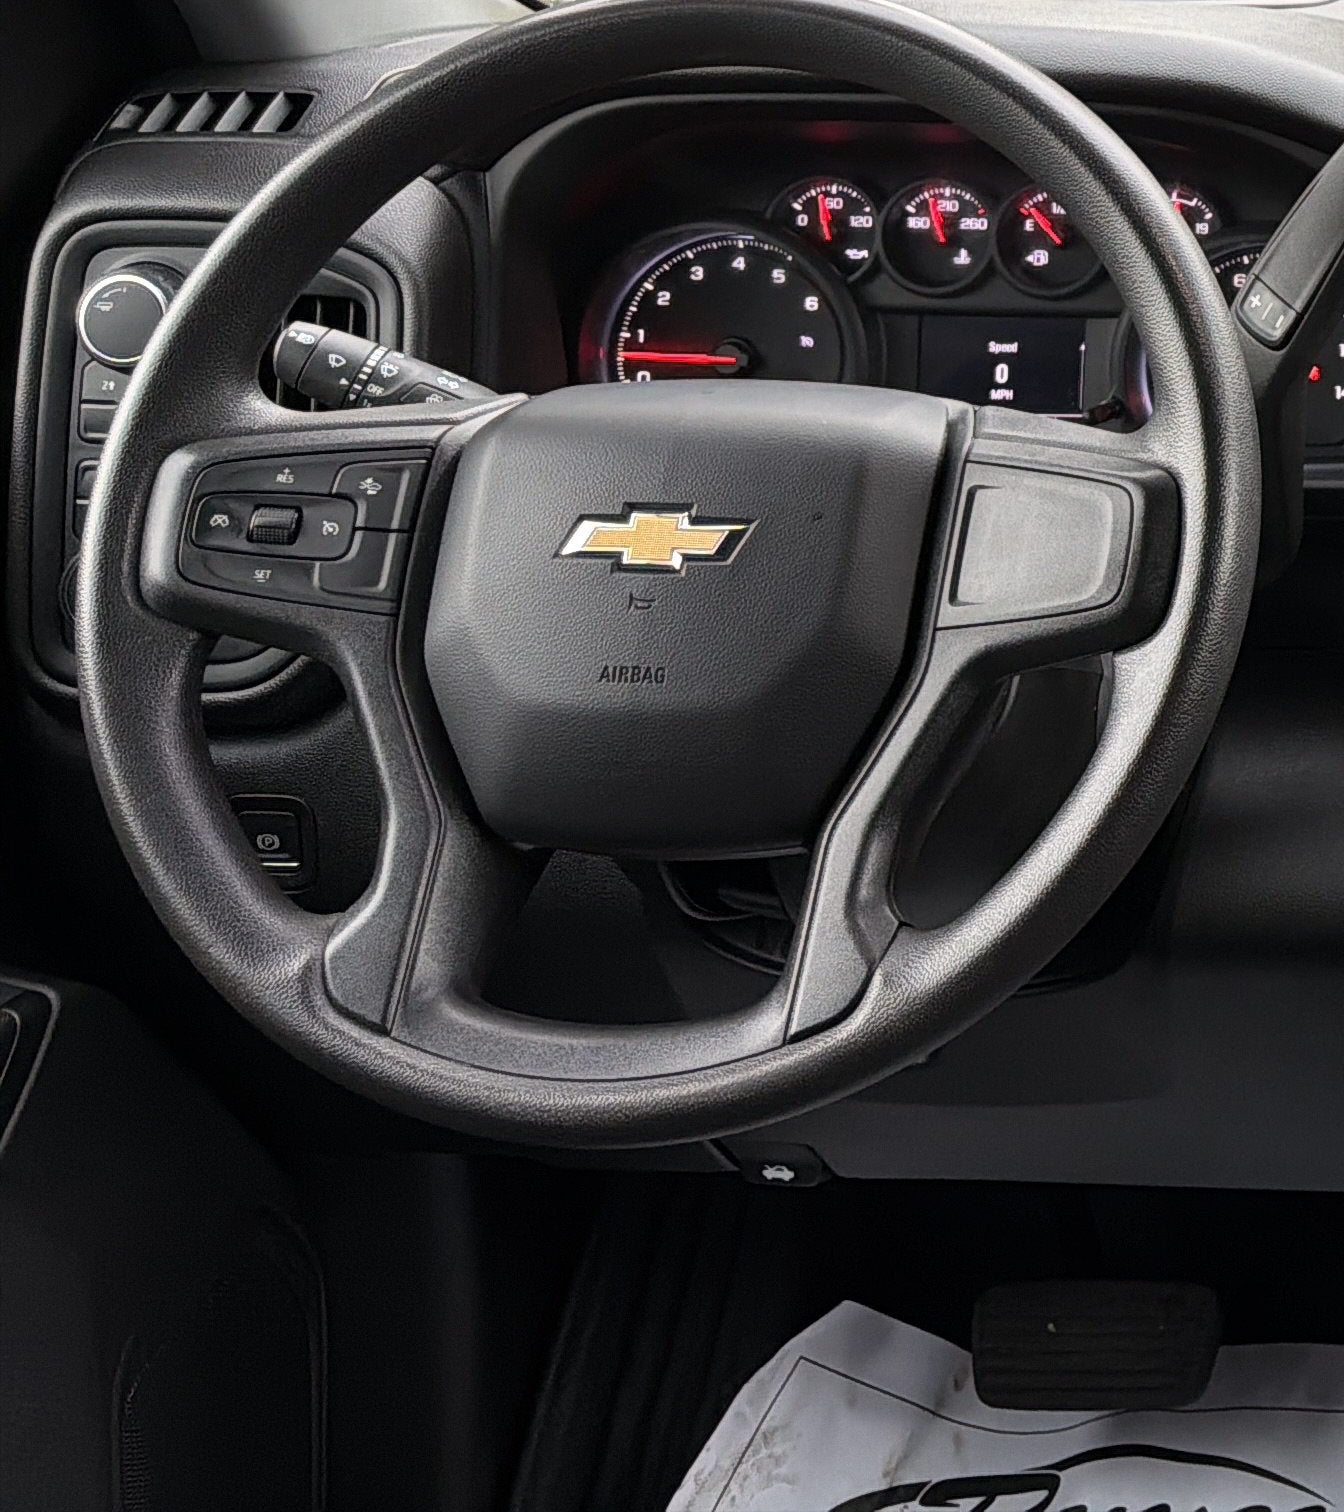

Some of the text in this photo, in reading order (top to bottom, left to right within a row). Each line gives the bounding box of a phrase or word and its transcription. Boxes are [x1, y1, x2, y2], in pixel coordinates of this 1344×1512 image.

[796, 216, 808, 227] 0
[850, 216, 873, 228] 120
[906, 216, 930, 229] 160
[959, 217, 988, 231] 260
[1024, 219, 1035, 231] E
[1195, 222, 1209, 234] 19
[731, 256, 746, 271] 4
[689, 265, 704, 280] 3
[771, 269, 786, 284] 5
[656, 291, 671, 306] 2
[804, 296, 819, 311] 6
[637, 328, 645, 343] 1
[988, 341, 1018, 355] Speed
[995, 363, 1009, 384] 0
[990, 389, 1014, 401] MPH
[276, 473, 294, 484] RES
[254, 569, 271, 579] SET
[598, 665, 666, 684] AIRBAG
